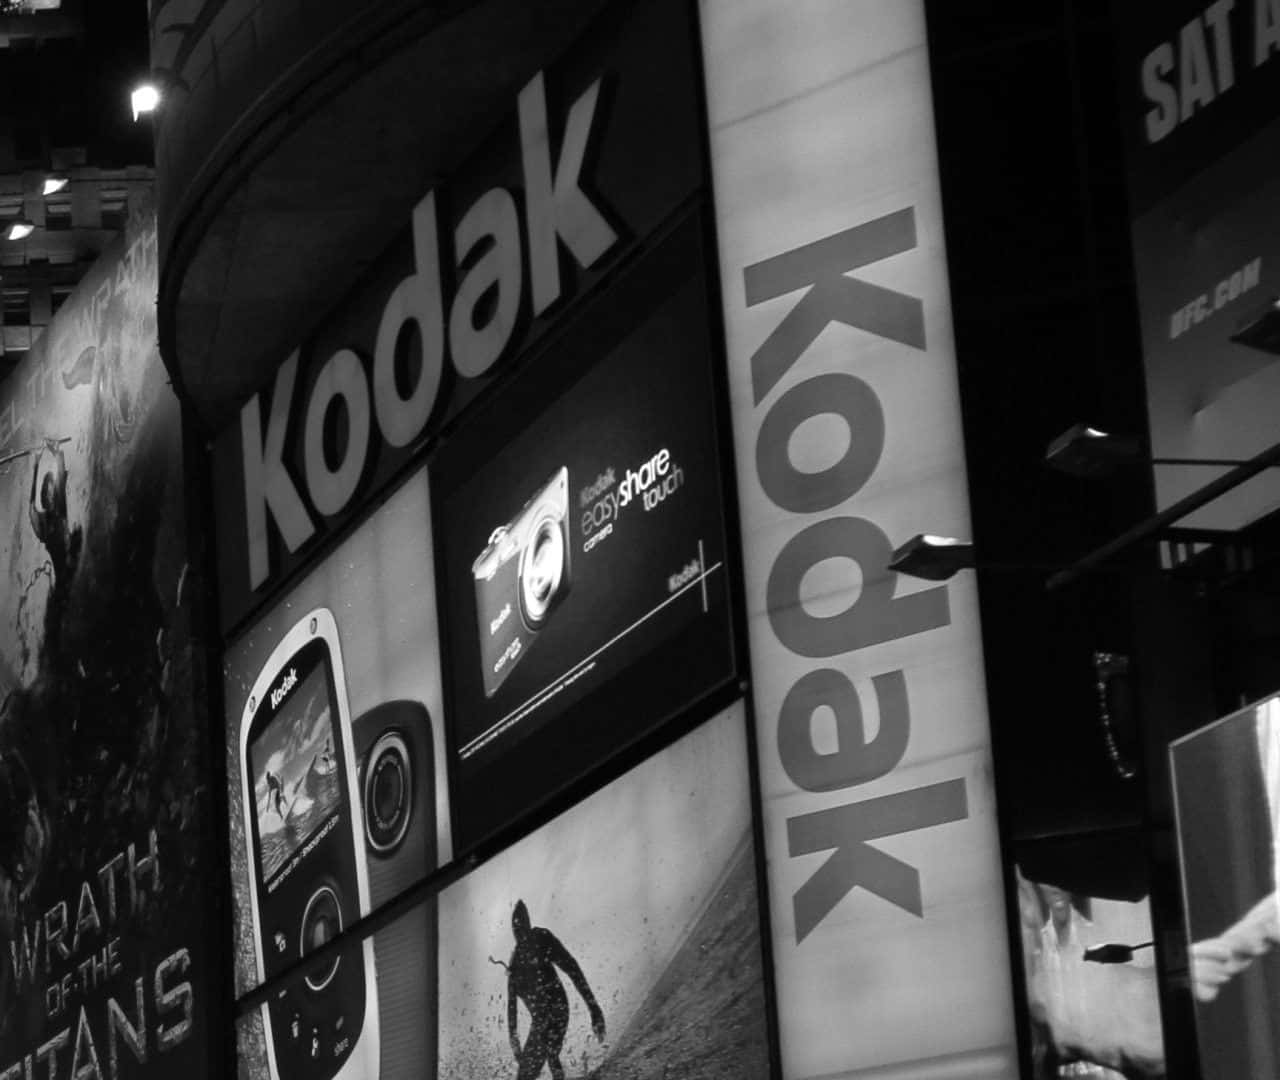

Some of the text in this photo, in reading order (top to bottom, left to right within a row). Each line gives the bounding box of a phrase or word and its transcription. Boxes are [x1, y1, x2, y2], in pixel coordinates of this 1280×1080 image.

[1141, 0, 1237, 145] SAT
[240, 68, 620, 594] Kodak
[583, 523, 614, 553] camera
[642, 464, 686, 512] touch
[743, 205, 969, 947] Kodak
[270, 667, 299, 711] Kodak
[9, 827, 162, 994] WRATH
